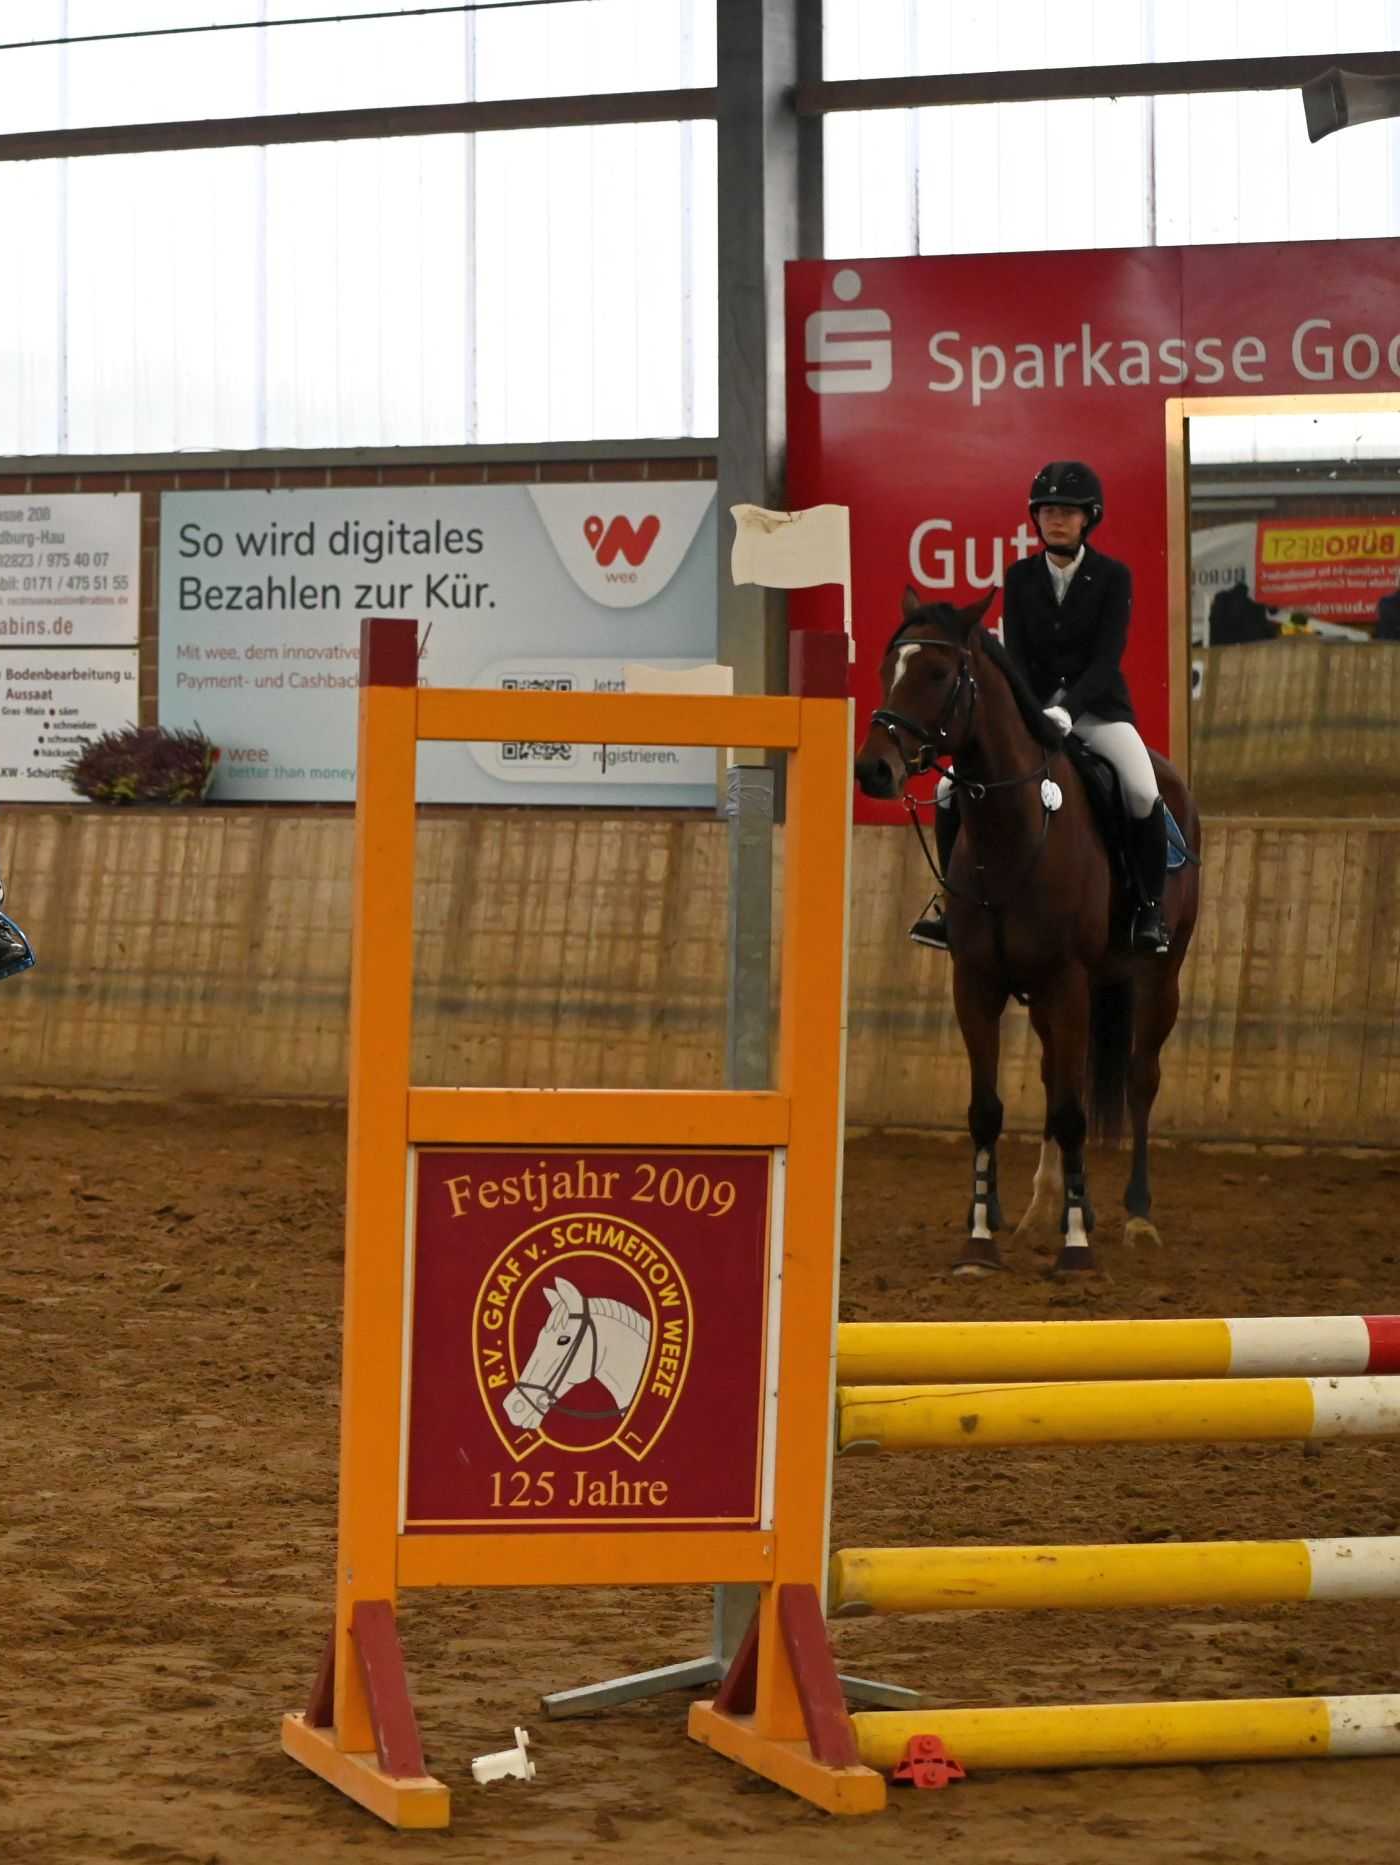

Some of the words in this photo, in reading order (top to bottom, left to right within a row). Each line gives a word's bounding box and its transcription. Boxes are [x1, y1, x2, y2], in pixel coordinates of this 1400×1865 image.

[927, 323, 1266, 405] Sparkasse
[179, 523, 224, 558] So
[236, 522, 315, 556] wird
[329, 519, 484, 564] digitales
[605, 573, 639, 584] wee
[179, 576, 342, 611] Bezahlen
[354, 582, 413, 610] zur
[426, 573, 496, 609] Kür.
[177, 645, 201, 659] Mit
[245, 644, 278, 659] dem
[6, 667, 121, 684] Bodenbearbeitung
[176, 672, 249, 690] Payment-
[255, 672, 283, 689] und
[6, 688, 53, 701] Aussaat
[228, 747, 270, 763] wee
[274, 766, 305, 779] than
[310, 768, 356, 781] money
[442, 1160, 620, 1218] Festjahr
[631, 1162, 737, 1218] 2009
[483, 1257, 523, 1331] GRAF
[551, 1222, 682, 1309] SCHMETTOW
[651, 1318, 683, 1399] WEEZE
[490, 1471, 555, 1507] 125
[568, 1470, 669, 1507] Jahre
